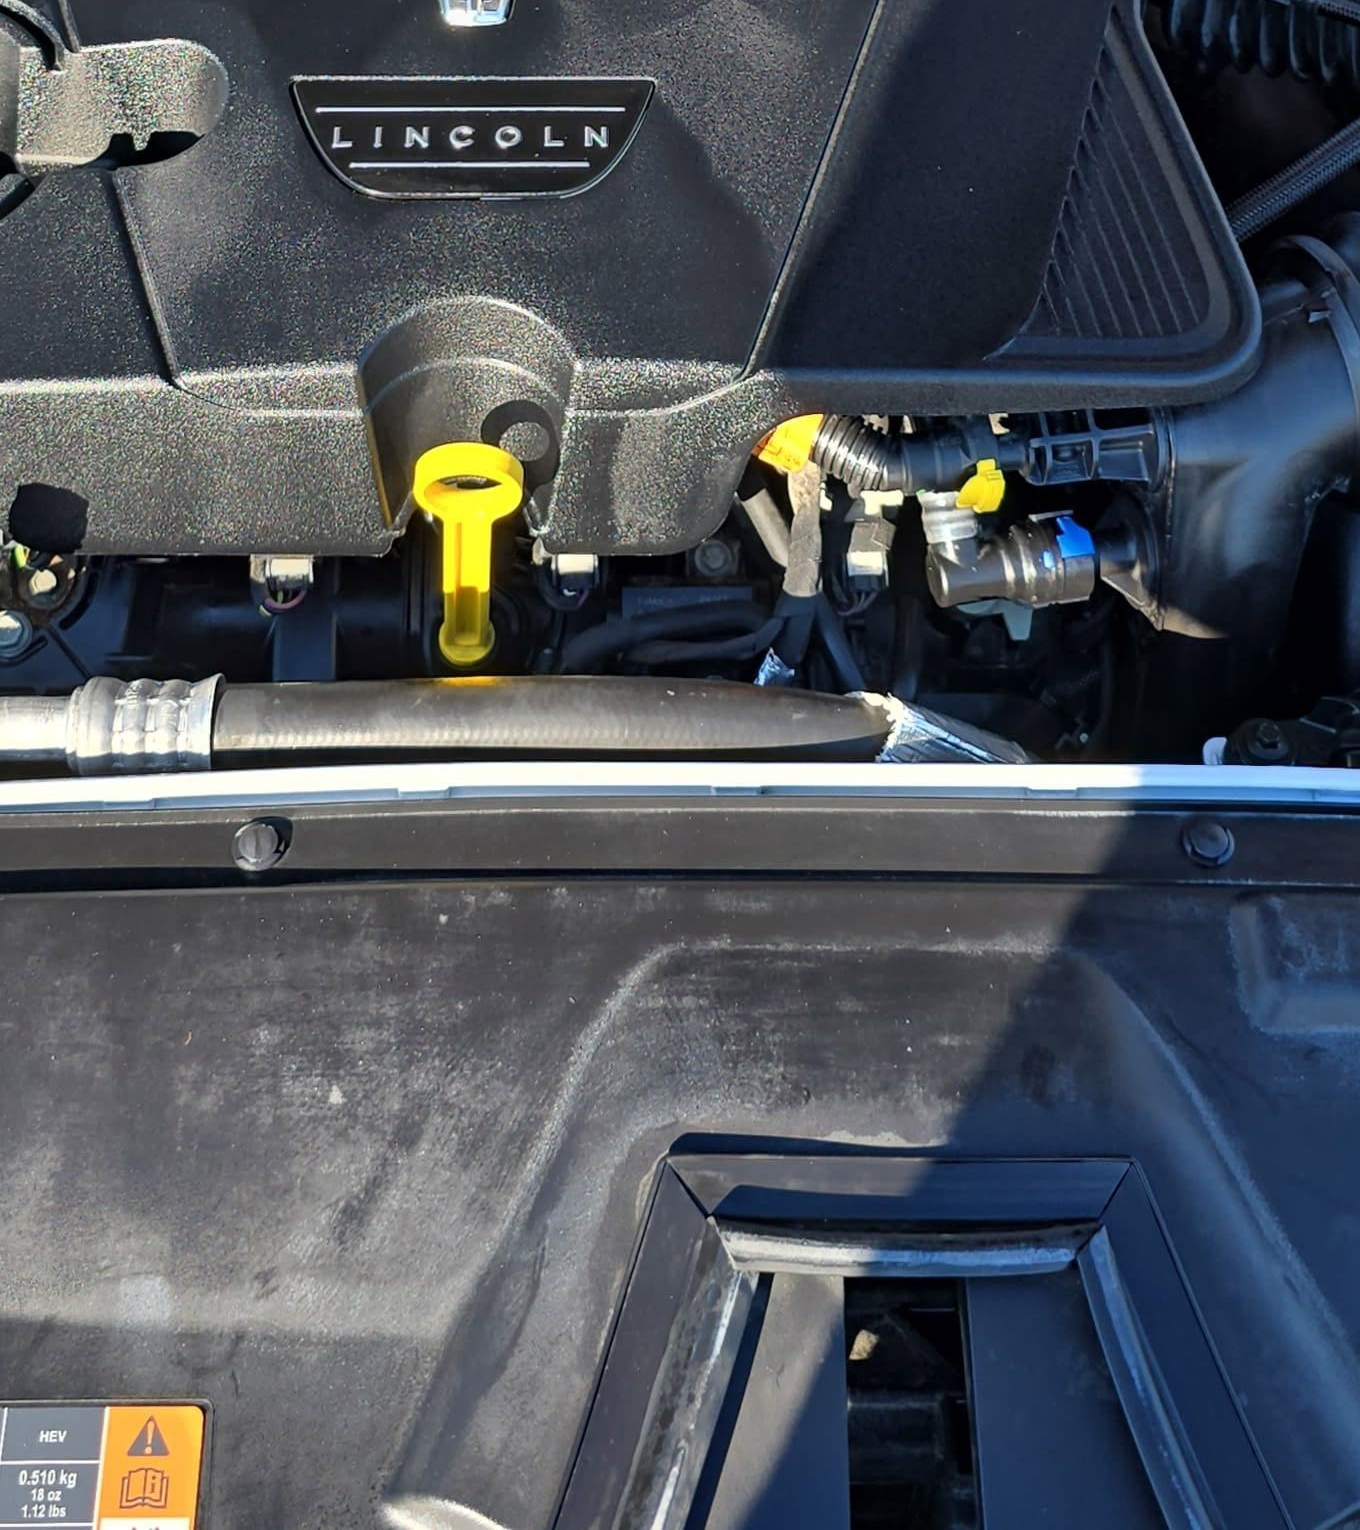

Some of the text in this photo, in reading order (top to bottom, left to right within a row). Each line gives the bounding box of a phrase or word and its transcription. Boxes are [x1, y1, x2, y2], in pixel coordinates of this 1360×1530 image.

[331, 125, 609, 149] LINCOLN
[39, 1430, 67, 1443] HEV
[18, 1469, 77, 1489] 0.510 kg
[31, 1488, 62, 1502] 18 oz
[21, 1504, 67, 1518] 1.12 lbs
